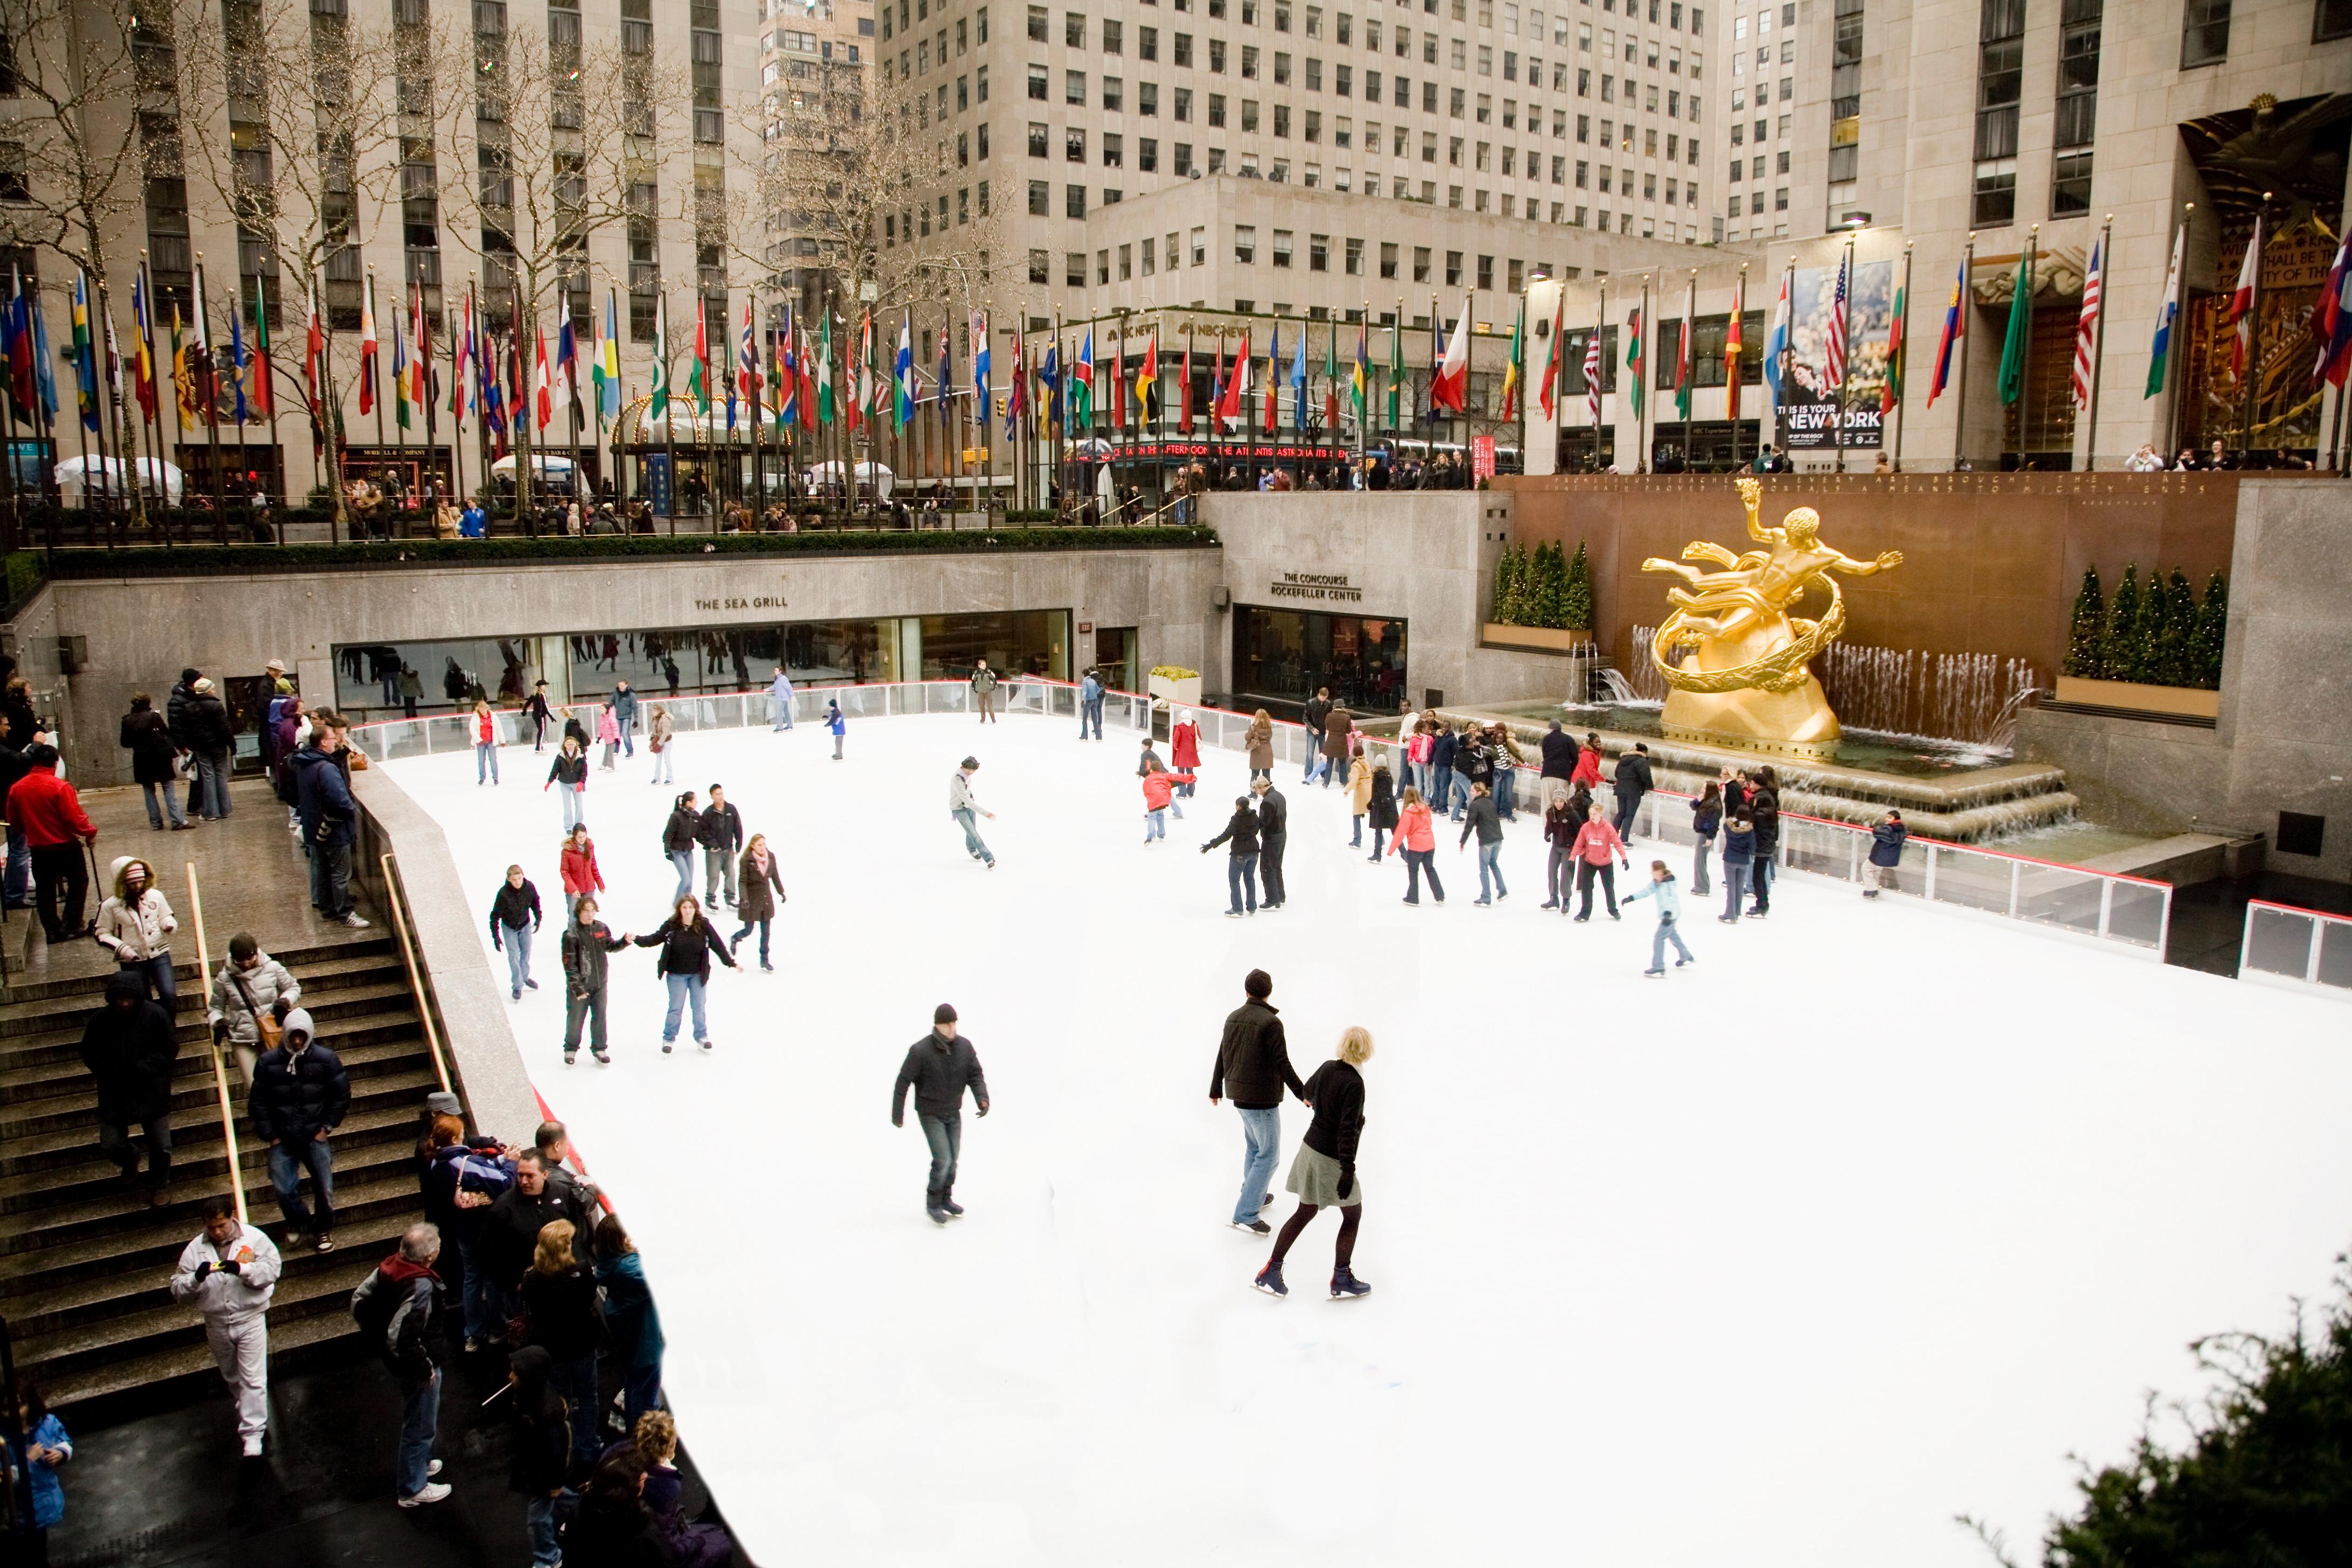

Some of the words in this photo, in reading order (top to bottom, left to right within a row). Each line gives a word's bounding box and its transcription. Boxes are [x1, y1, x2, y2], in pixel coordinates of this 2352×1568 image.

[2300, 251, 2315, 264] BE
[2283, 270, 2302, 282] OF
[1198, 325, 1220, 337] NBC
[1799, 404, 1808, 414] IS
[1810, 404, 1836, 414] YOUR
[1788, 413, 1826, 430] NEW
[1831, 411, 1882, 429] YORK
[2058, 475, 2097, 484] THE
[2127, 475, 2188, 484] FIRE
[1889, 485, 1954, 493] MEANS
[1977, 485, 1999, 493] TO
[2144, 485, 2205, 494] ENDS
[1284, 572, 1298, 584] THE
[1299, 574, 1348, 586] CONCOURSE
[1271, 586, 1326, 599] ROCKEFELLER
[1328, 590, 1362, 603] CENTER
[695, 599, 720, 610] THE
[724, 598, 748, 609] SEA
[753, 596, 789, 608] GRILL
